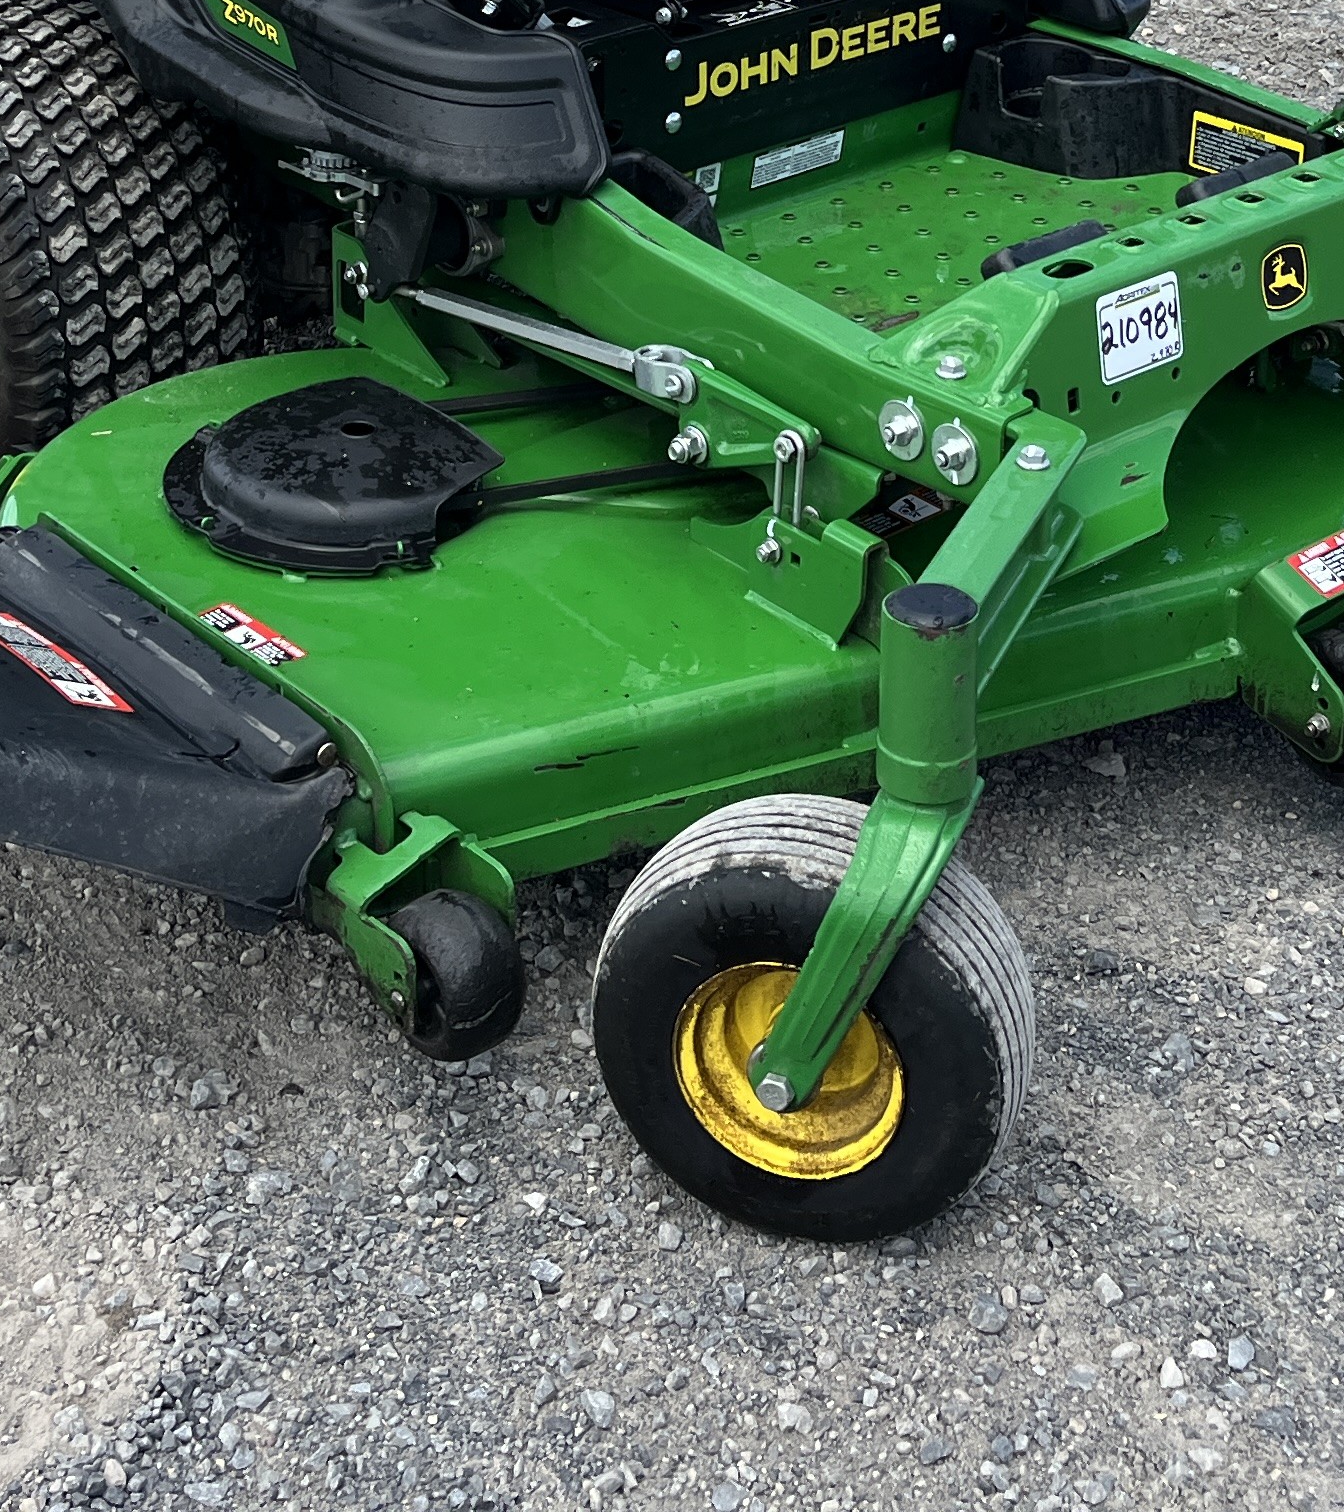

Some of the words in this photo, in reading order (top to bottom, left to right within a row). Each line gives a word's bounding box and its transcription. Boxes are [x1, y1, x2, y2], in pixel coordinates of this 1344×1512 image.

[684, 42, 799, 107] JOHN
[810, 3, 942, 71] DEERE
[1101, 297, 1178, 356] 210984
